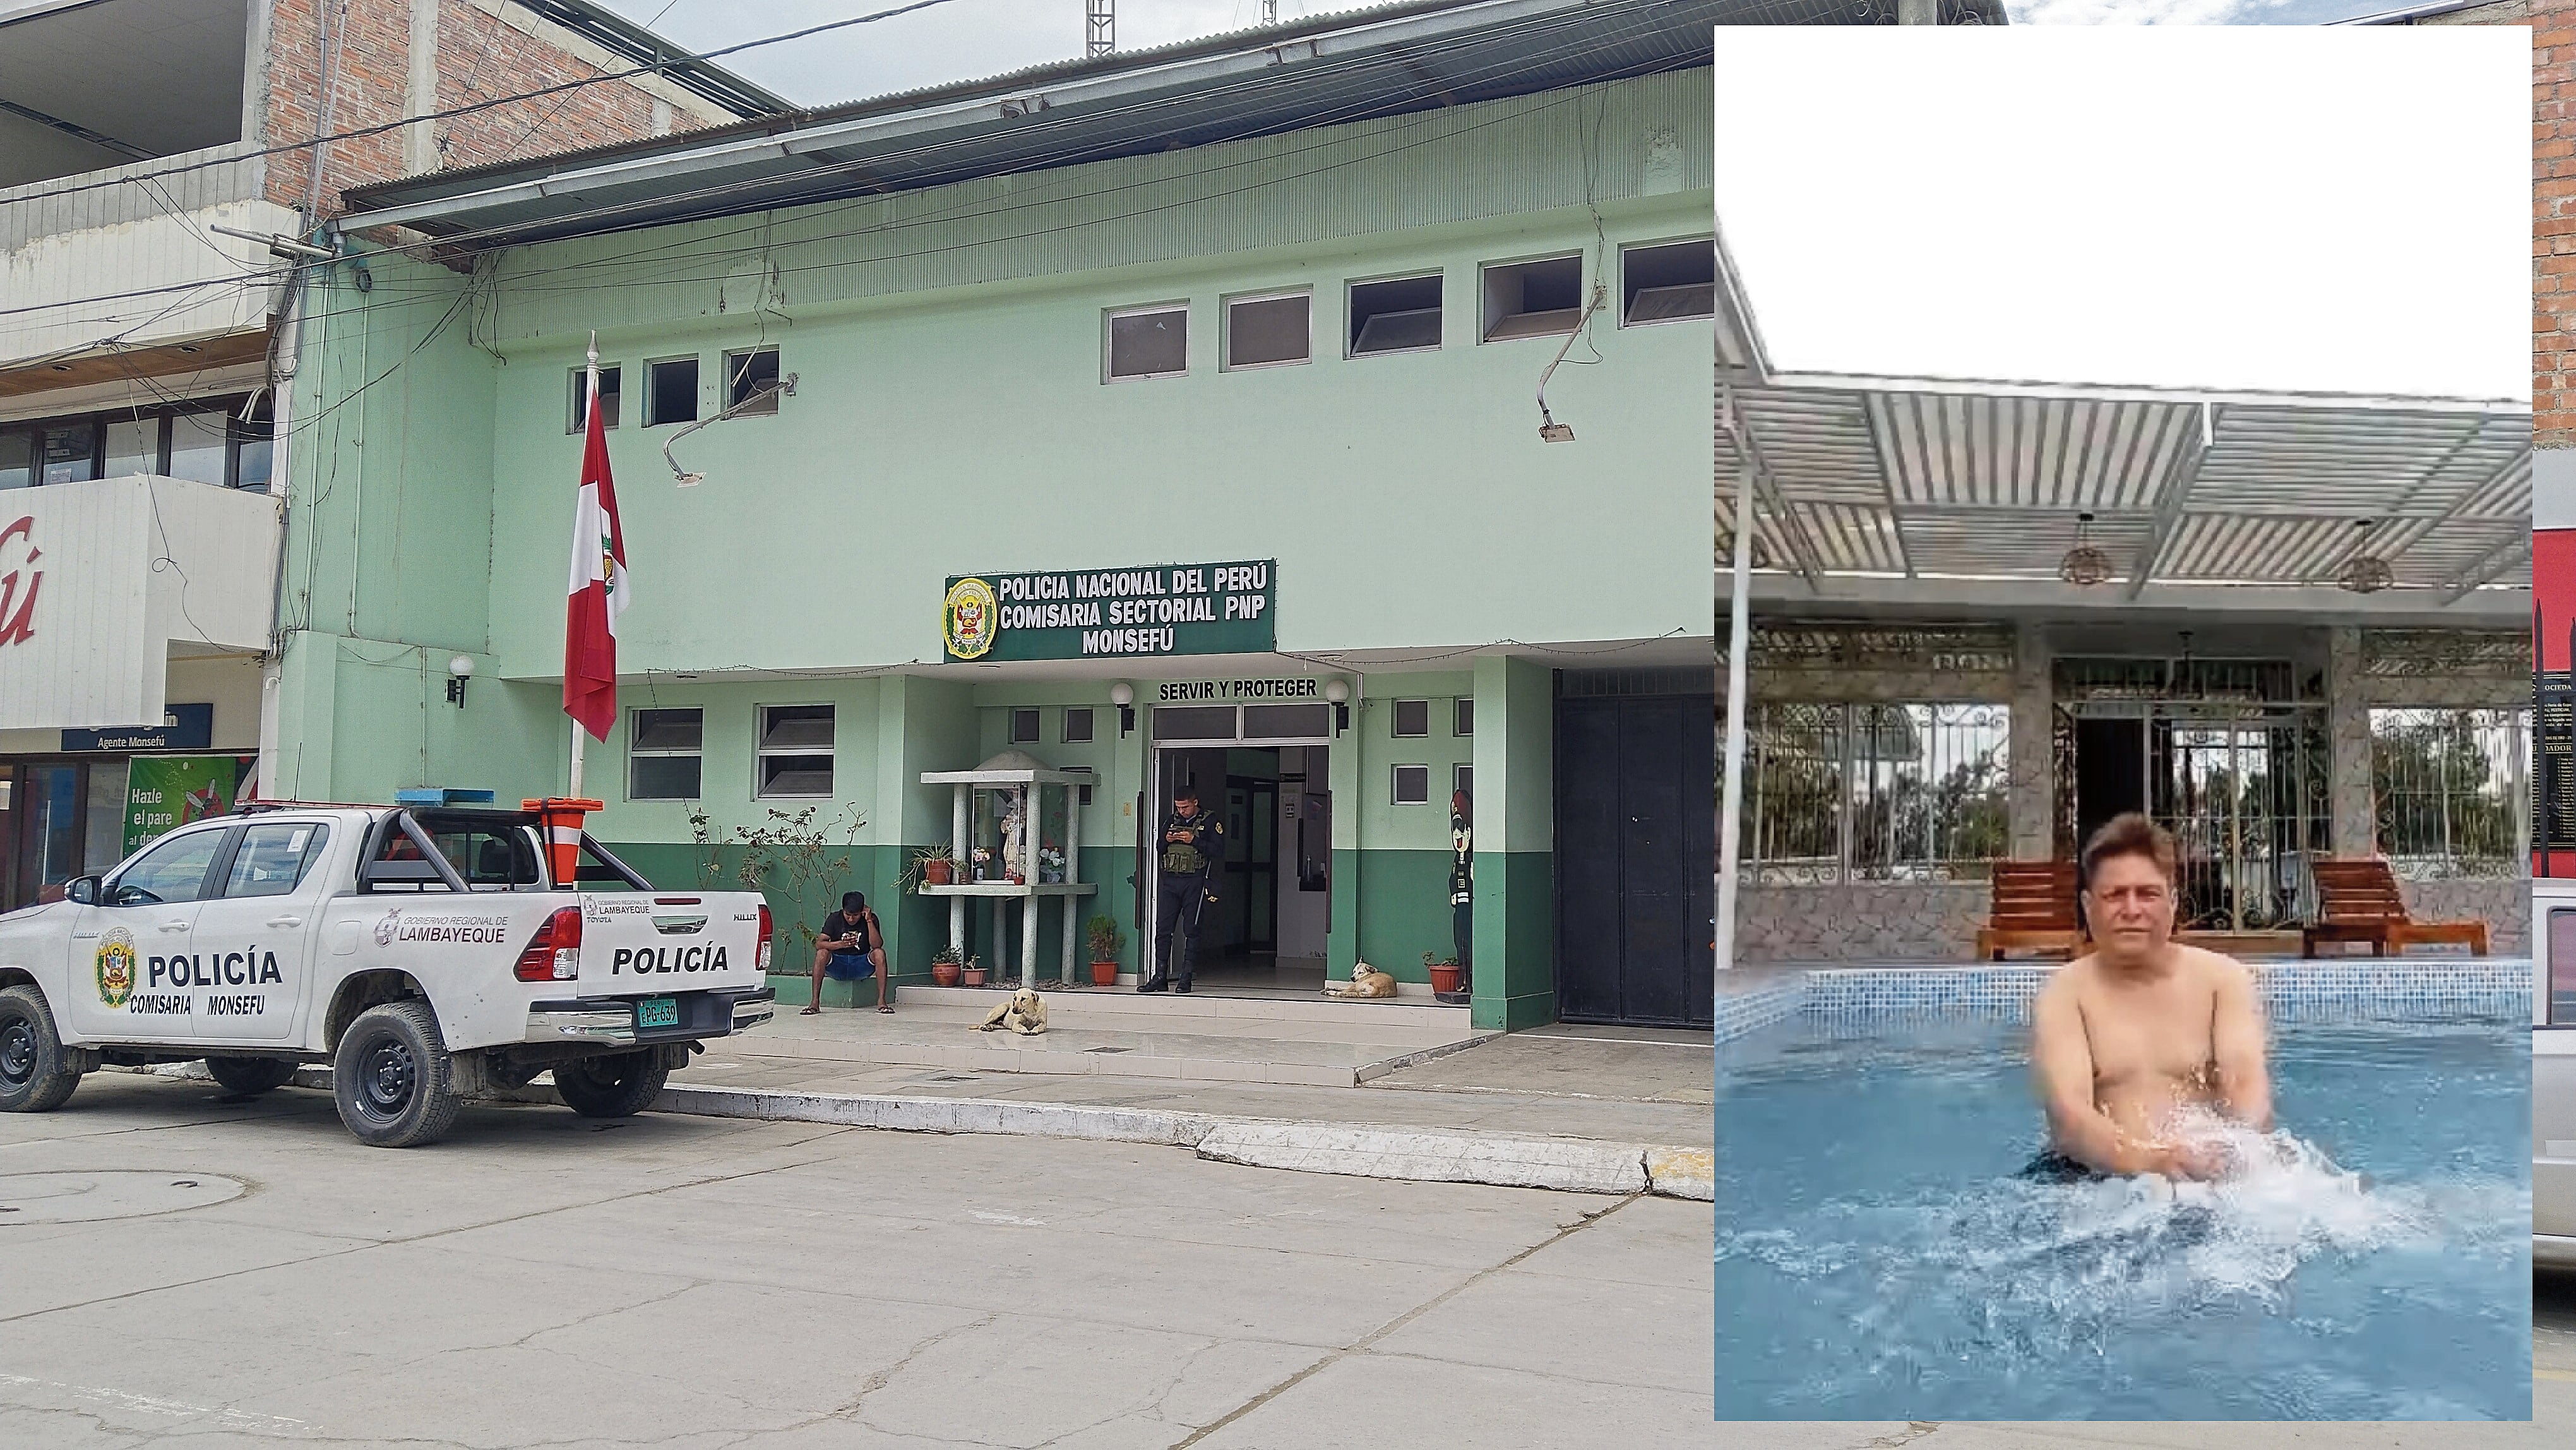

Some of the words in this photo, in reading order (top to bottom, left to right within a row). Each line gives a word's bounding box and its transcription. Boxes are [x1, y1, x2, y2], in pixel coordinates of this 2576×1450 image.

[999, 575, 1070, 601] POLICIA
[1076, 570, 1166, 598] NACIONAL
[1172, 568, 1207, 594] DEL
[1214, 562, 1267, 592] PERÚ
[1000, 601, 1101, 629] COMISARIA
[1109, 597, 1216, 625] SECTORIAL
[1225, 595, 1265, 620] PNP
[1082, 623, 1174, 654] MONSEFÚ
[1159, 681, 1215, 700] SERVIR
[1219, 680, 1229, 697] Y
[1234, 679, 1316, 697] PROTEGER
[97, 737, 126, 749] Agente
[129, 734, 165, 747] Monsefú
[131, 788, 162, 803] Hazle
[134, 809, 145, 825] el
[147, 813, 172, 828] pare
[128, 836, 136, 845] al
[403, 916, 448, 925] GOBIERNO
[450, 916, 494, 925] REGIONAL
[496, 916, 508, 925] DE
[399, 927, 505, 943] LAMBAYEQUE
[148, 944, 282, 987] POLICÍA
[612, 940, 728, 974] POLICÍA
[130, 995, 191, 1015] COMISARIA
[207, 995, 265, 1015] MONSEFU
